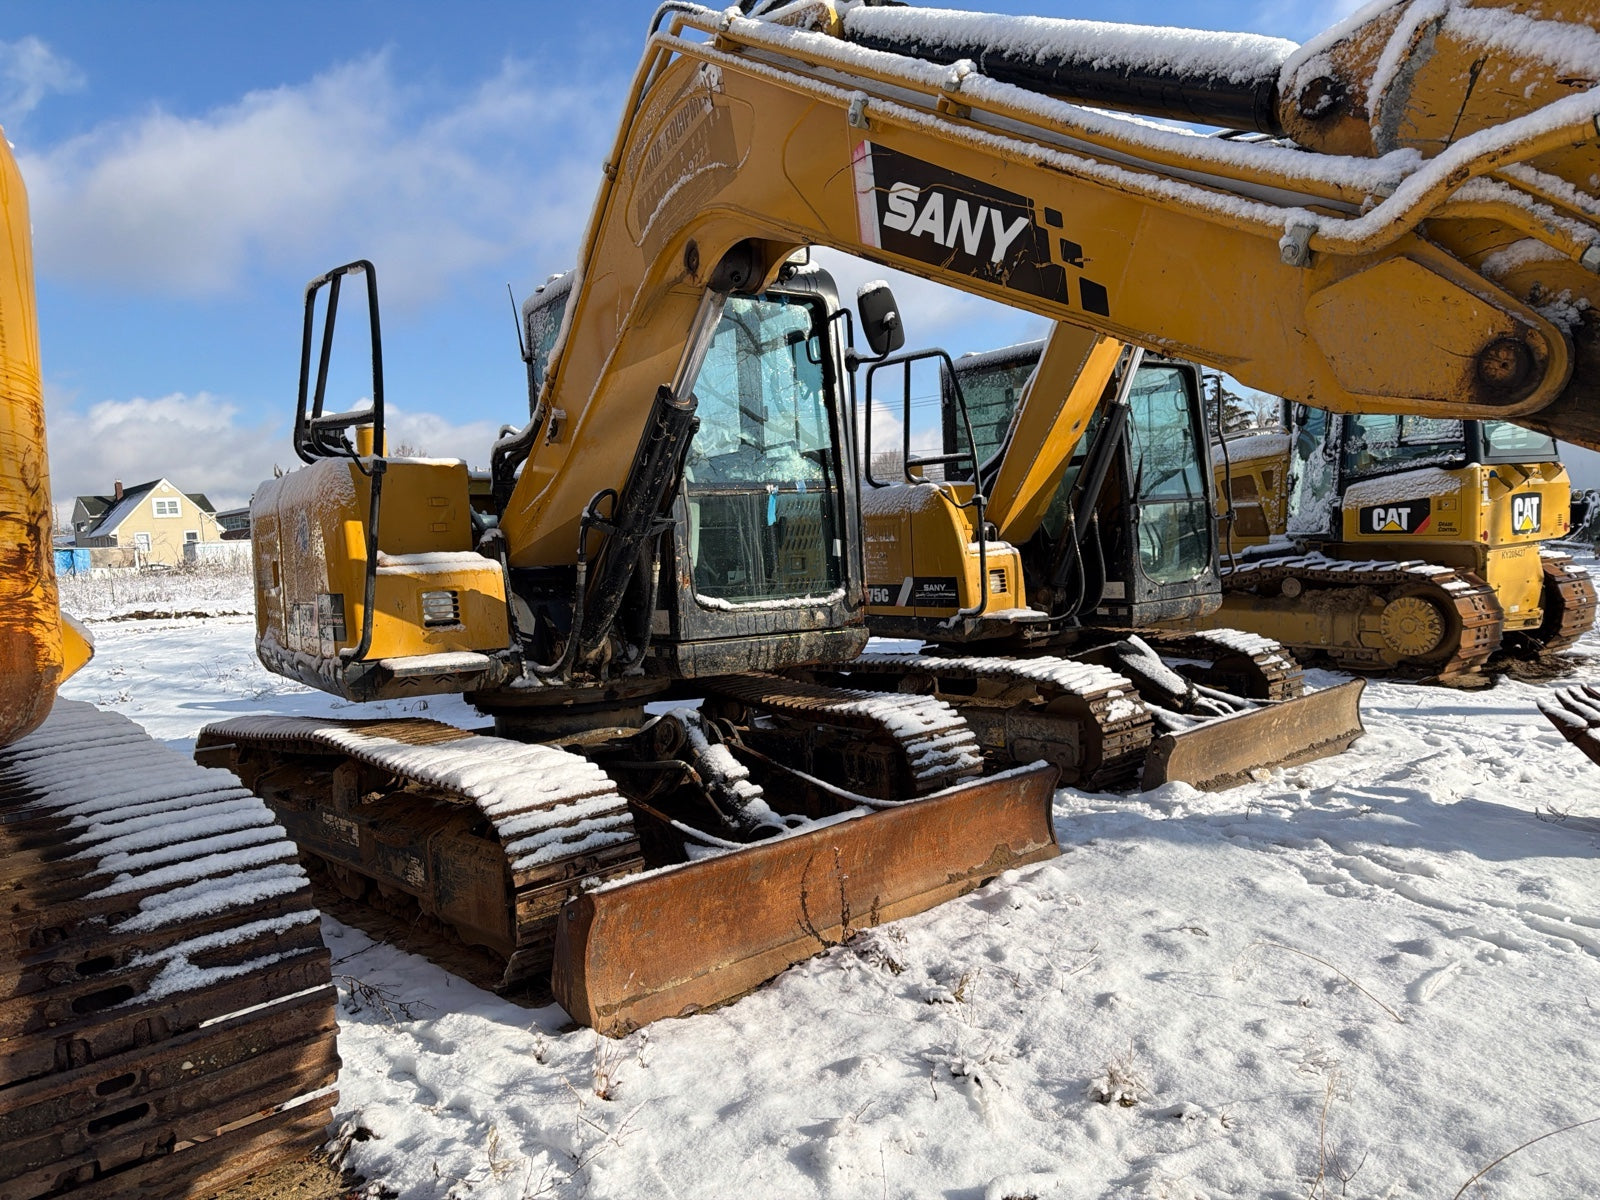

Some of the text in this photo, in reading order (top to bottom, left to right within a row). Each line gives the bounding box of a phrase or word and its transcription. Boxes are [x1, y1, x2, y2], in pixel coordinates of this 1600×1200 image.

[883, 181, 1030, 264] SANY
[1372, 507, 1412, 532] CAT
[1513, 497, 1540, 531] CAT
[923, 583, 946, 591] SANY
